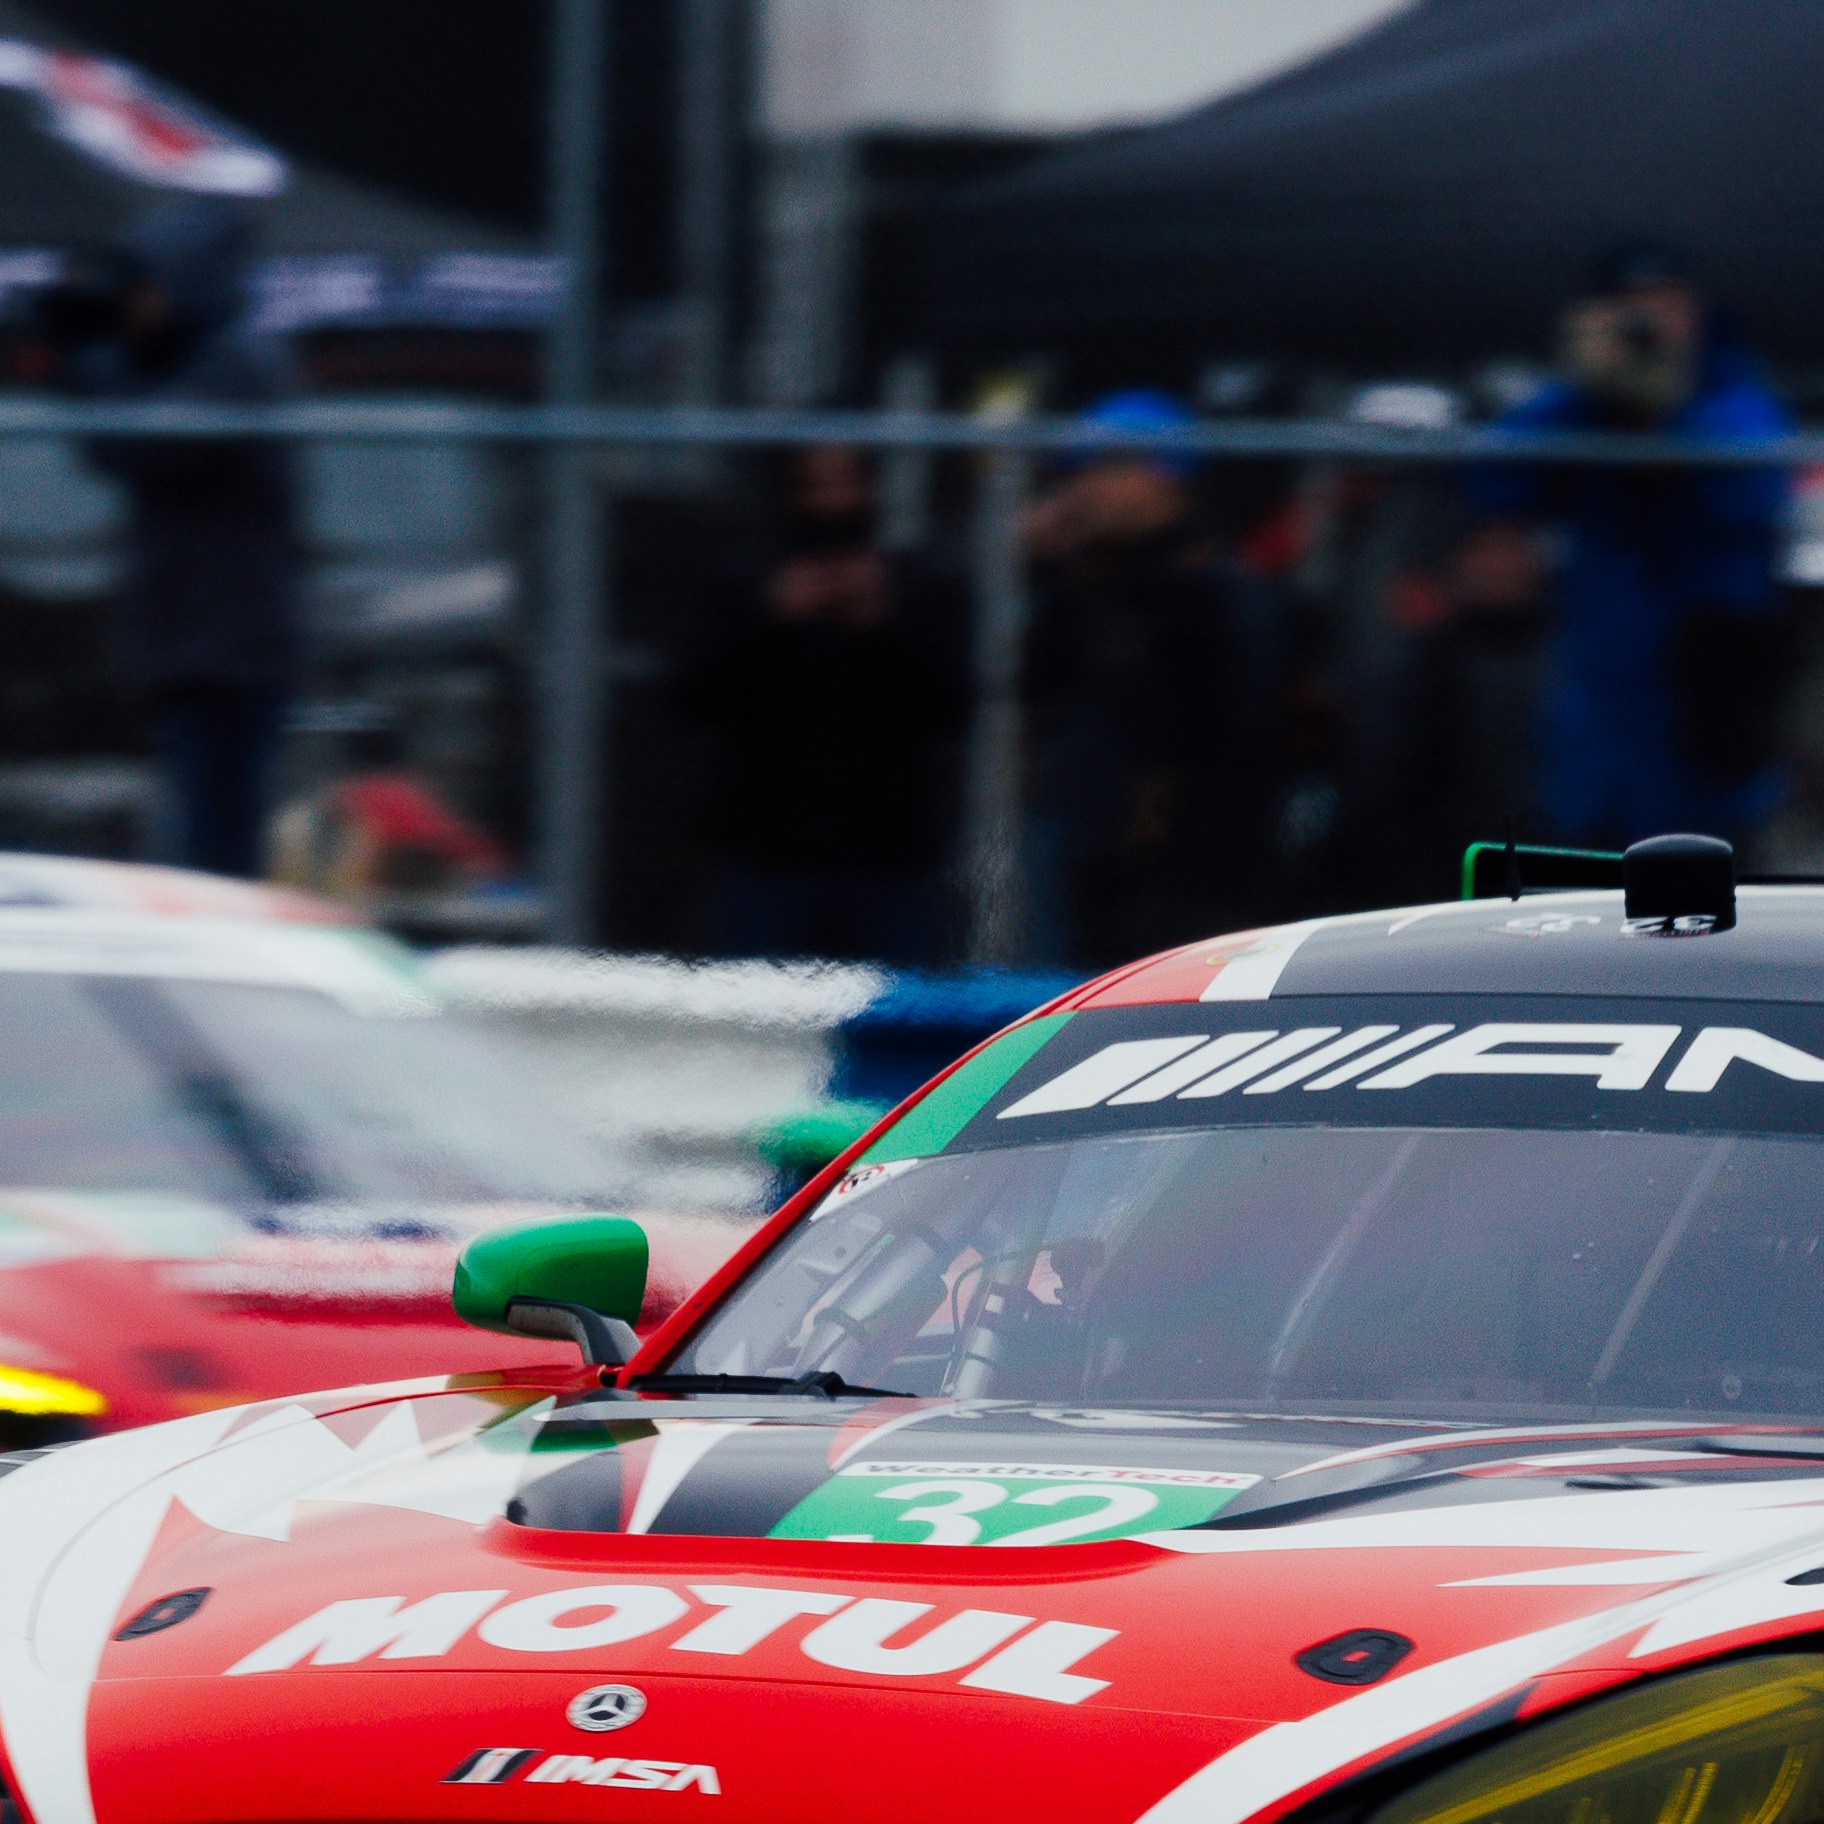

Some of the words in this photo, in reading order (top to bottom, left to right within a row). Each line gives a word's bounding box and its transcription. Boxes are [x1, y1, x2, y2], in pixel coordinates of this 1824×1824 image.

[865, 1462, 1240, 1486] WeatherTech
[826, 1479, 1160, 1546] 32
[223, 1584, 1121, 1703] MOTUL
[522, 1754, 723, 1796] IMSA
